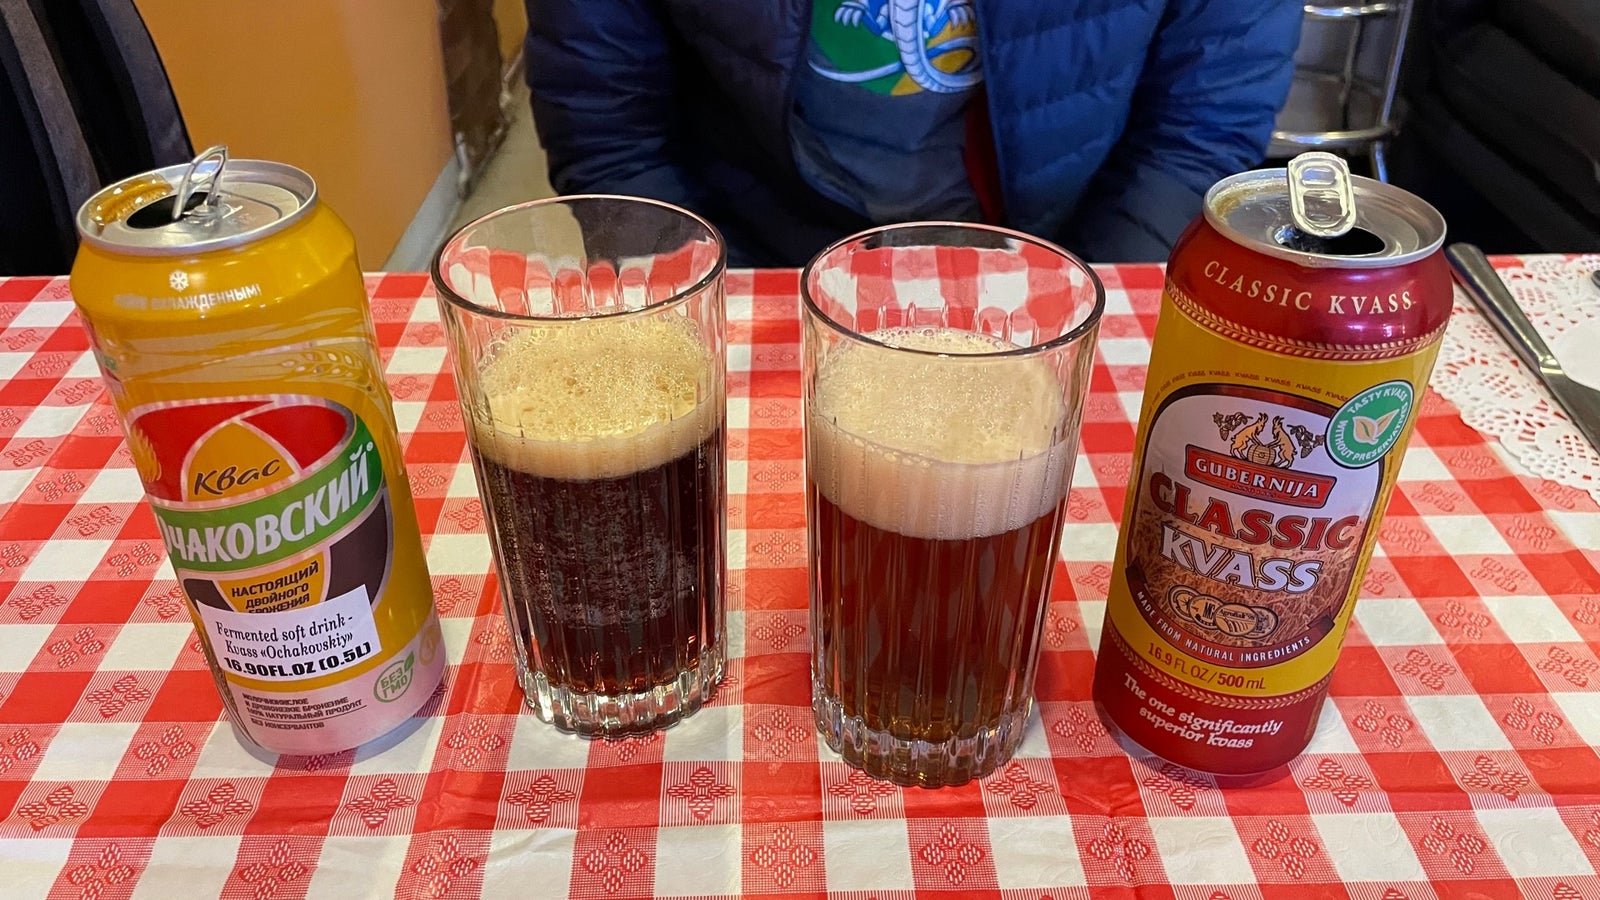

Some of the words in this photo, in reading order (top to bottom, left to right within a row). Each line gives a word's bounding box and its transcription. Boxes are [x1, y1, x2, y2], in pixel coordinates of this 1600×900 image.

[1204, 260, 1312, 311] CLASSIC
[1328, 291, 1412, 315] KVASS
[1347, 390, 1382, 414] TASTY
[1335, 420, 1355, 458] WITHOUT
[1195, 458, 1319, 498] GUBERNIJA
[1150, 472, 1360, 551] CLASSIC
[1160, 524, 1323, 593] KVASS
[231, 560, 319, 597] НАСТОЯЩИЙ
[245, 583, 309, 609] ДВОЙНОГО
[215, 621, 279, 643] Fermented
[282, 625, 306, 642] soft
[309, 613, 346, 636] drink
[1137, 591, 1155, 617] MADE
[1157, 619, 1181, 641] FROM
[1185, 639, 1234, 662] NATURAL
[1240, 636, 1310, 662] INGREDIENTS
[224, 657, 316, 677] 16.90FL.OZ
[225, 639, 258, 659] Kvass
[1148, 642, 1173, 666] 16.9
[1174, 658, 1188, 675] FL
[1246, 677, 1266, 689] mL
[381, 667, 403, 688] БЕЗ
[382, 675, 408, 698] ГМО
[1124, 672, 1147, 700] The
[1148, 698, 1176, 717] one
[1178, 712, 1283, 735] significantly
[1139, 707, 1204, 742] superior
[1206, 732, 1253, 748] kvass
